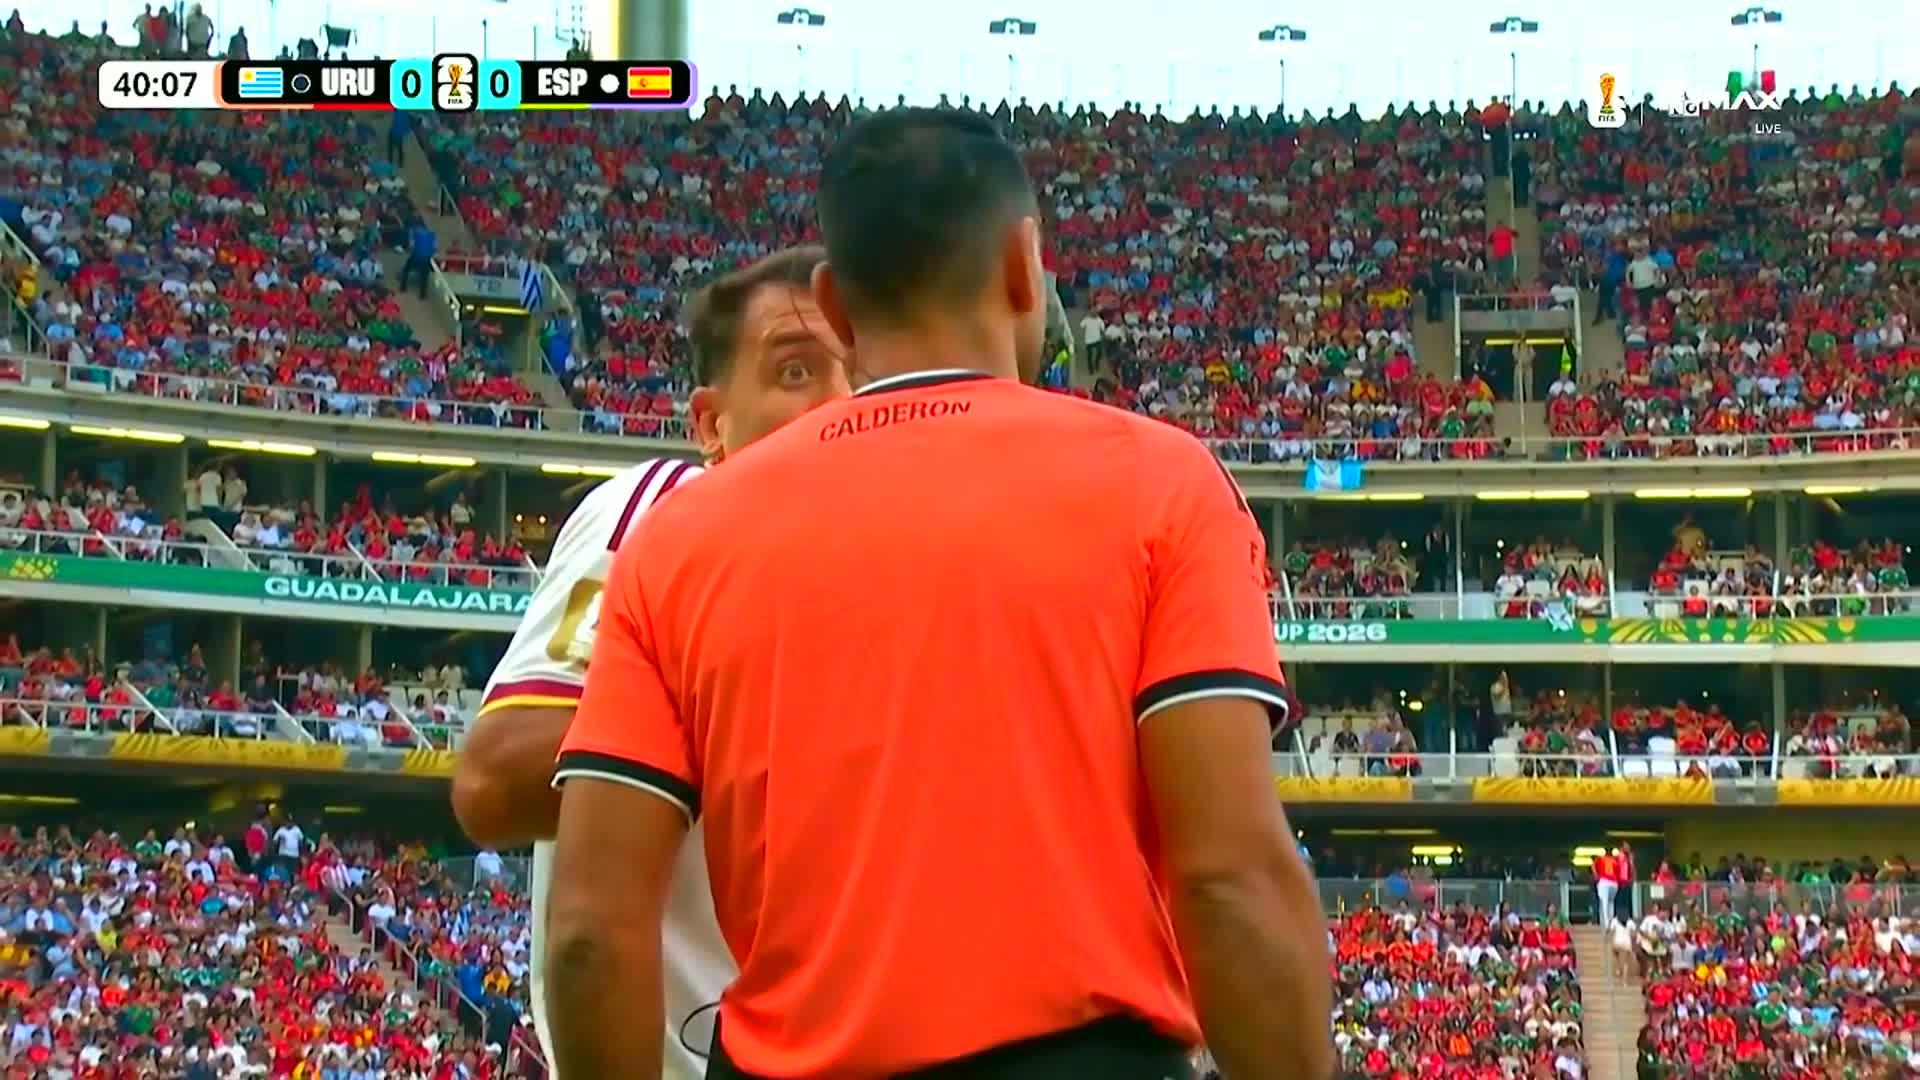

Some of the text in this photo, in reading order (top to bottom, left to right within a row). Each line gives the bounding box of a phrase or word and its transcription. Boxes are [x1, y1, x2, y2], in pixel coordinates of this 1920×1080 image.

[819, 400, 971, 442] CALDERON
[1273, 623, 1388, 642] UP 2026
